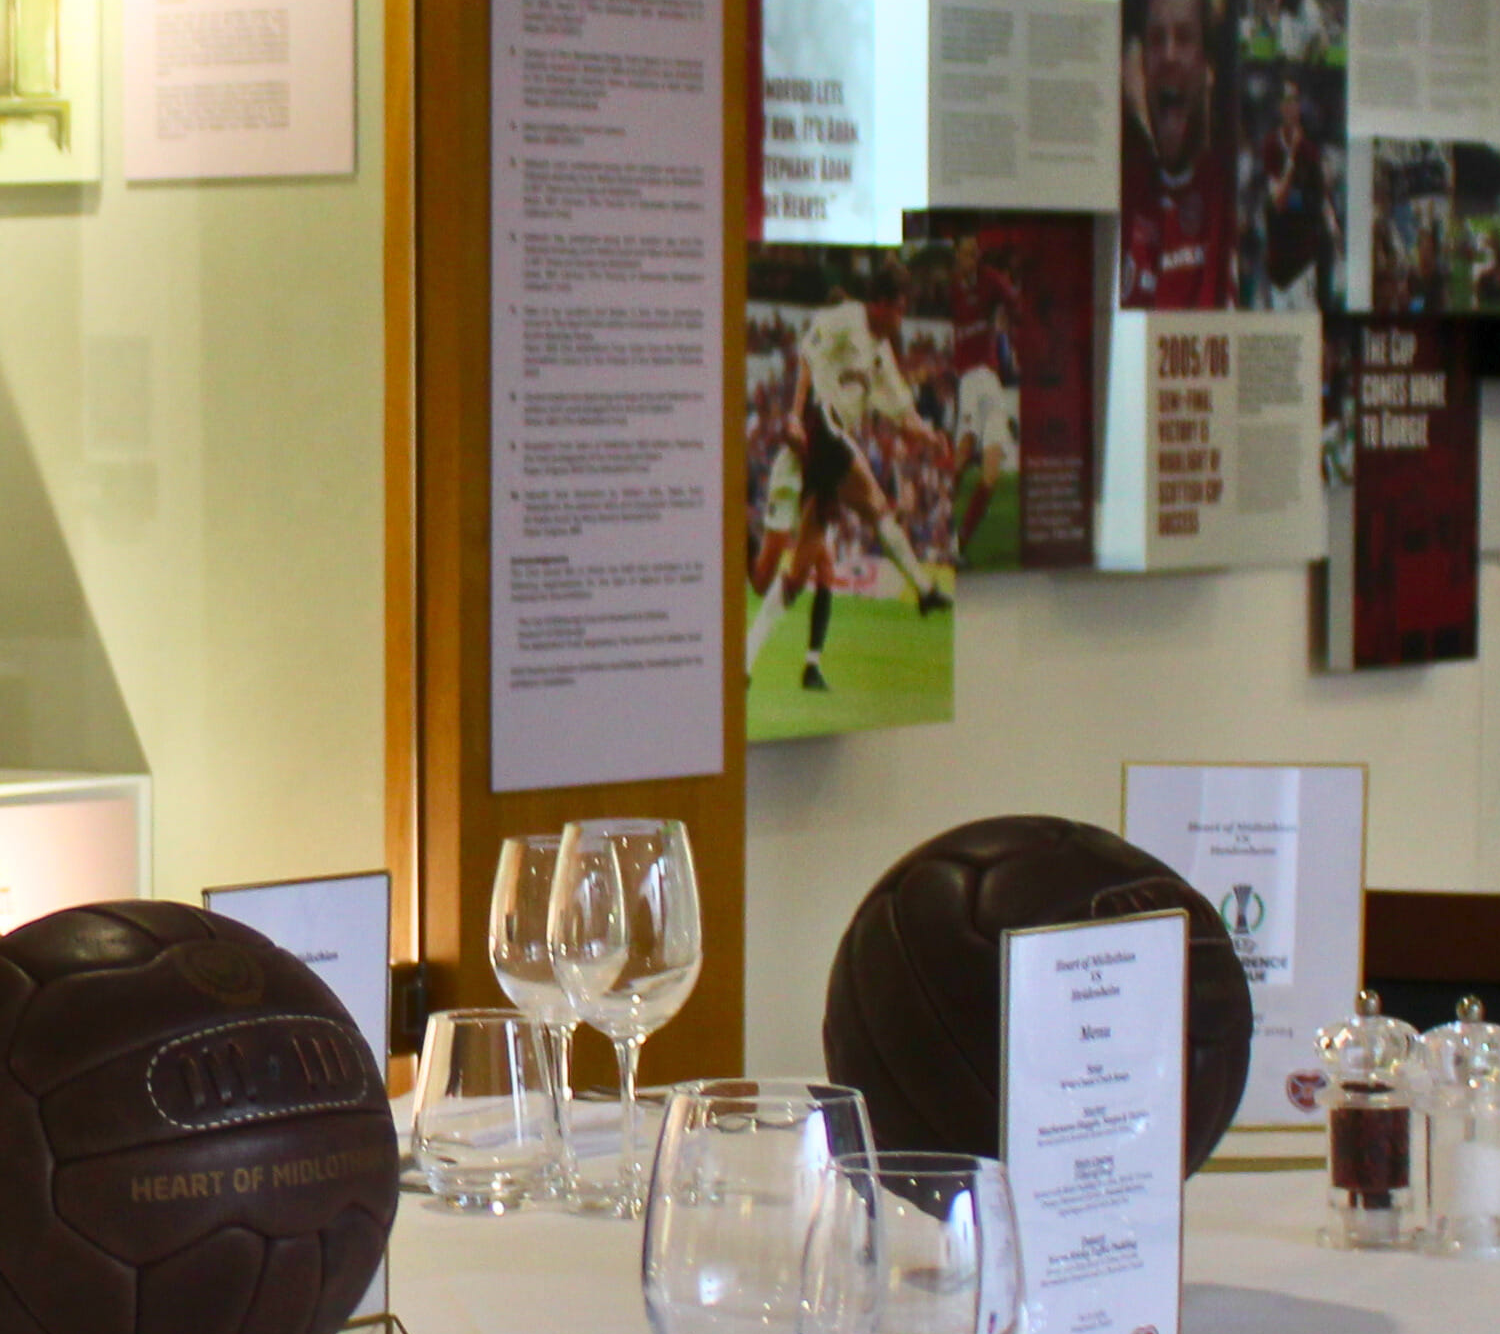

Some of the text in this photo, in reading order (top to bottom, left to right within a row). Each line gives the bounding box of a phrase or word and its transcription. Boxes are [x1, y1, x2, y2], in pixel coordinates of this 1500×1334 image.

[1157, 334, 1230, 379] 2005/06
[130, 1169, 225, 1203] HEART
[232, 1167, 265, 1195] OF
